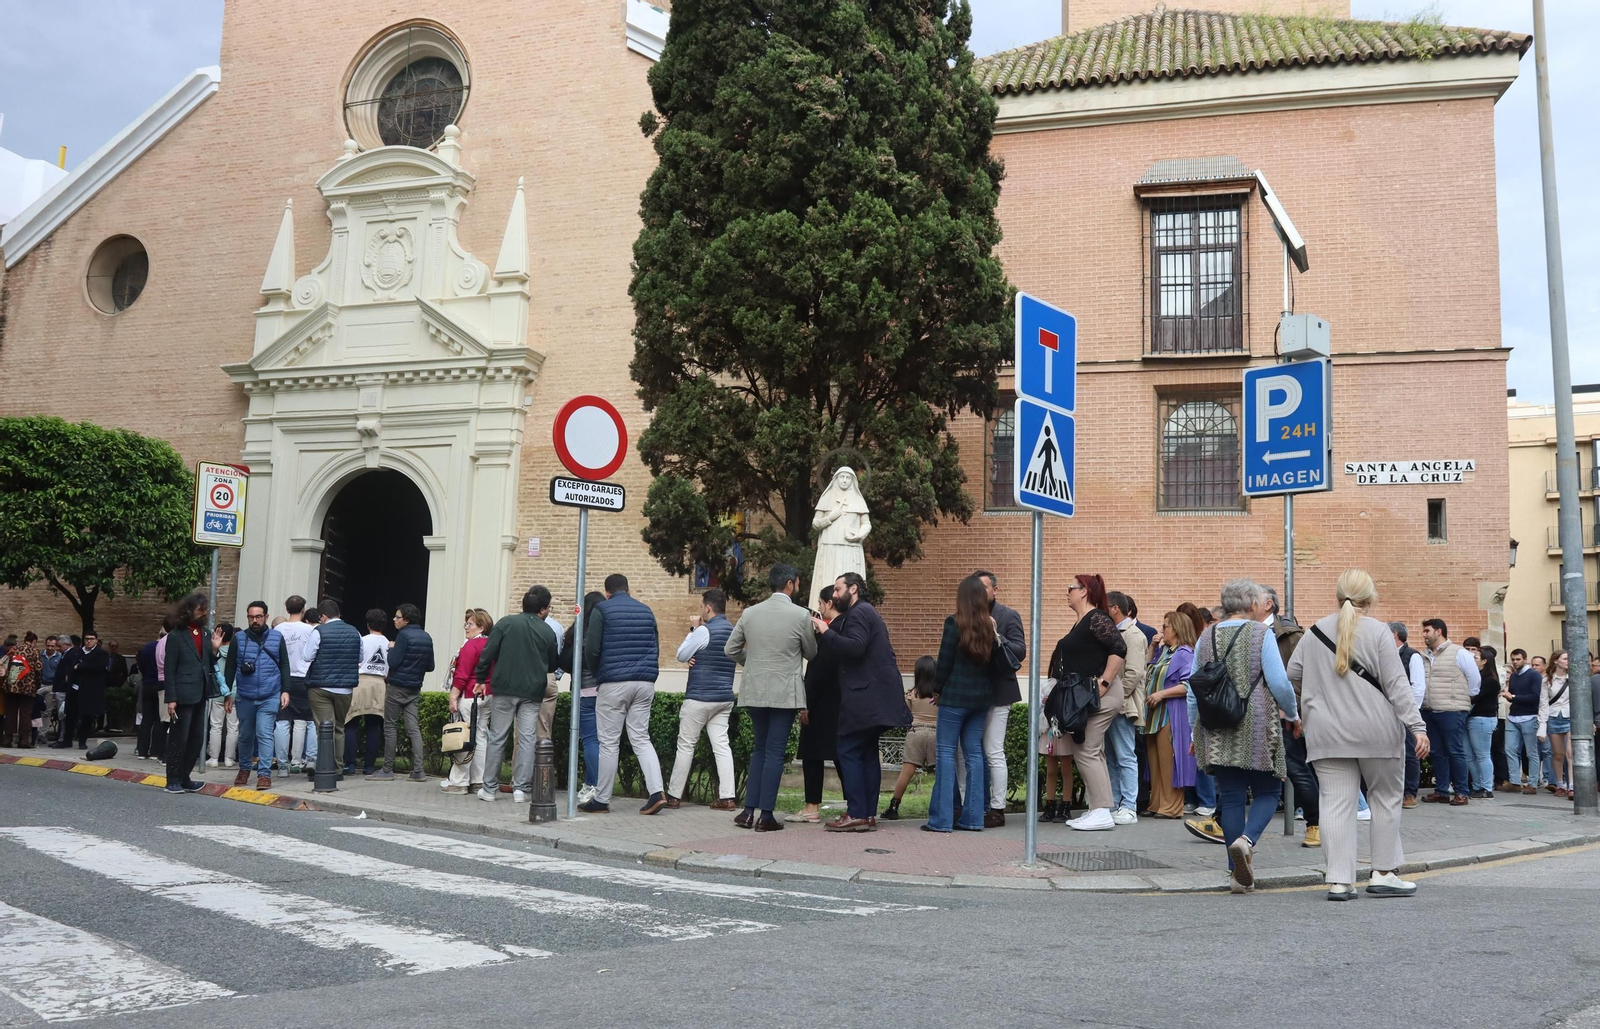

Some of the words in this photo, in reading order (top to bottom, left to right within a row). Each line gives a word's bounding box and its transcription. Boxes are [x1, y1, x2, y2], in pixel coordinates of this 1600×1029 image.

[1256, 374, 1302, 442] P
[1281, 422, 1316, 440] 24H
[1346, 463, 1398, 472] SANTA
[1410, 462, 1474, 471] ANGELA
[1248, 469, 1320, 488] IMAGEN
[1358, 474, 1378, 484] DE
[1390, 474, 1408, 482] LA
[1420, 473, 1462, 482] CRUZ
[558, 480, 590, 491] EXCEPTO
[591, 485, 622, 496] GARAJES
[216, 491, 229, 501] 20
[564, 492, 614, 506] AUTORIZADOS
